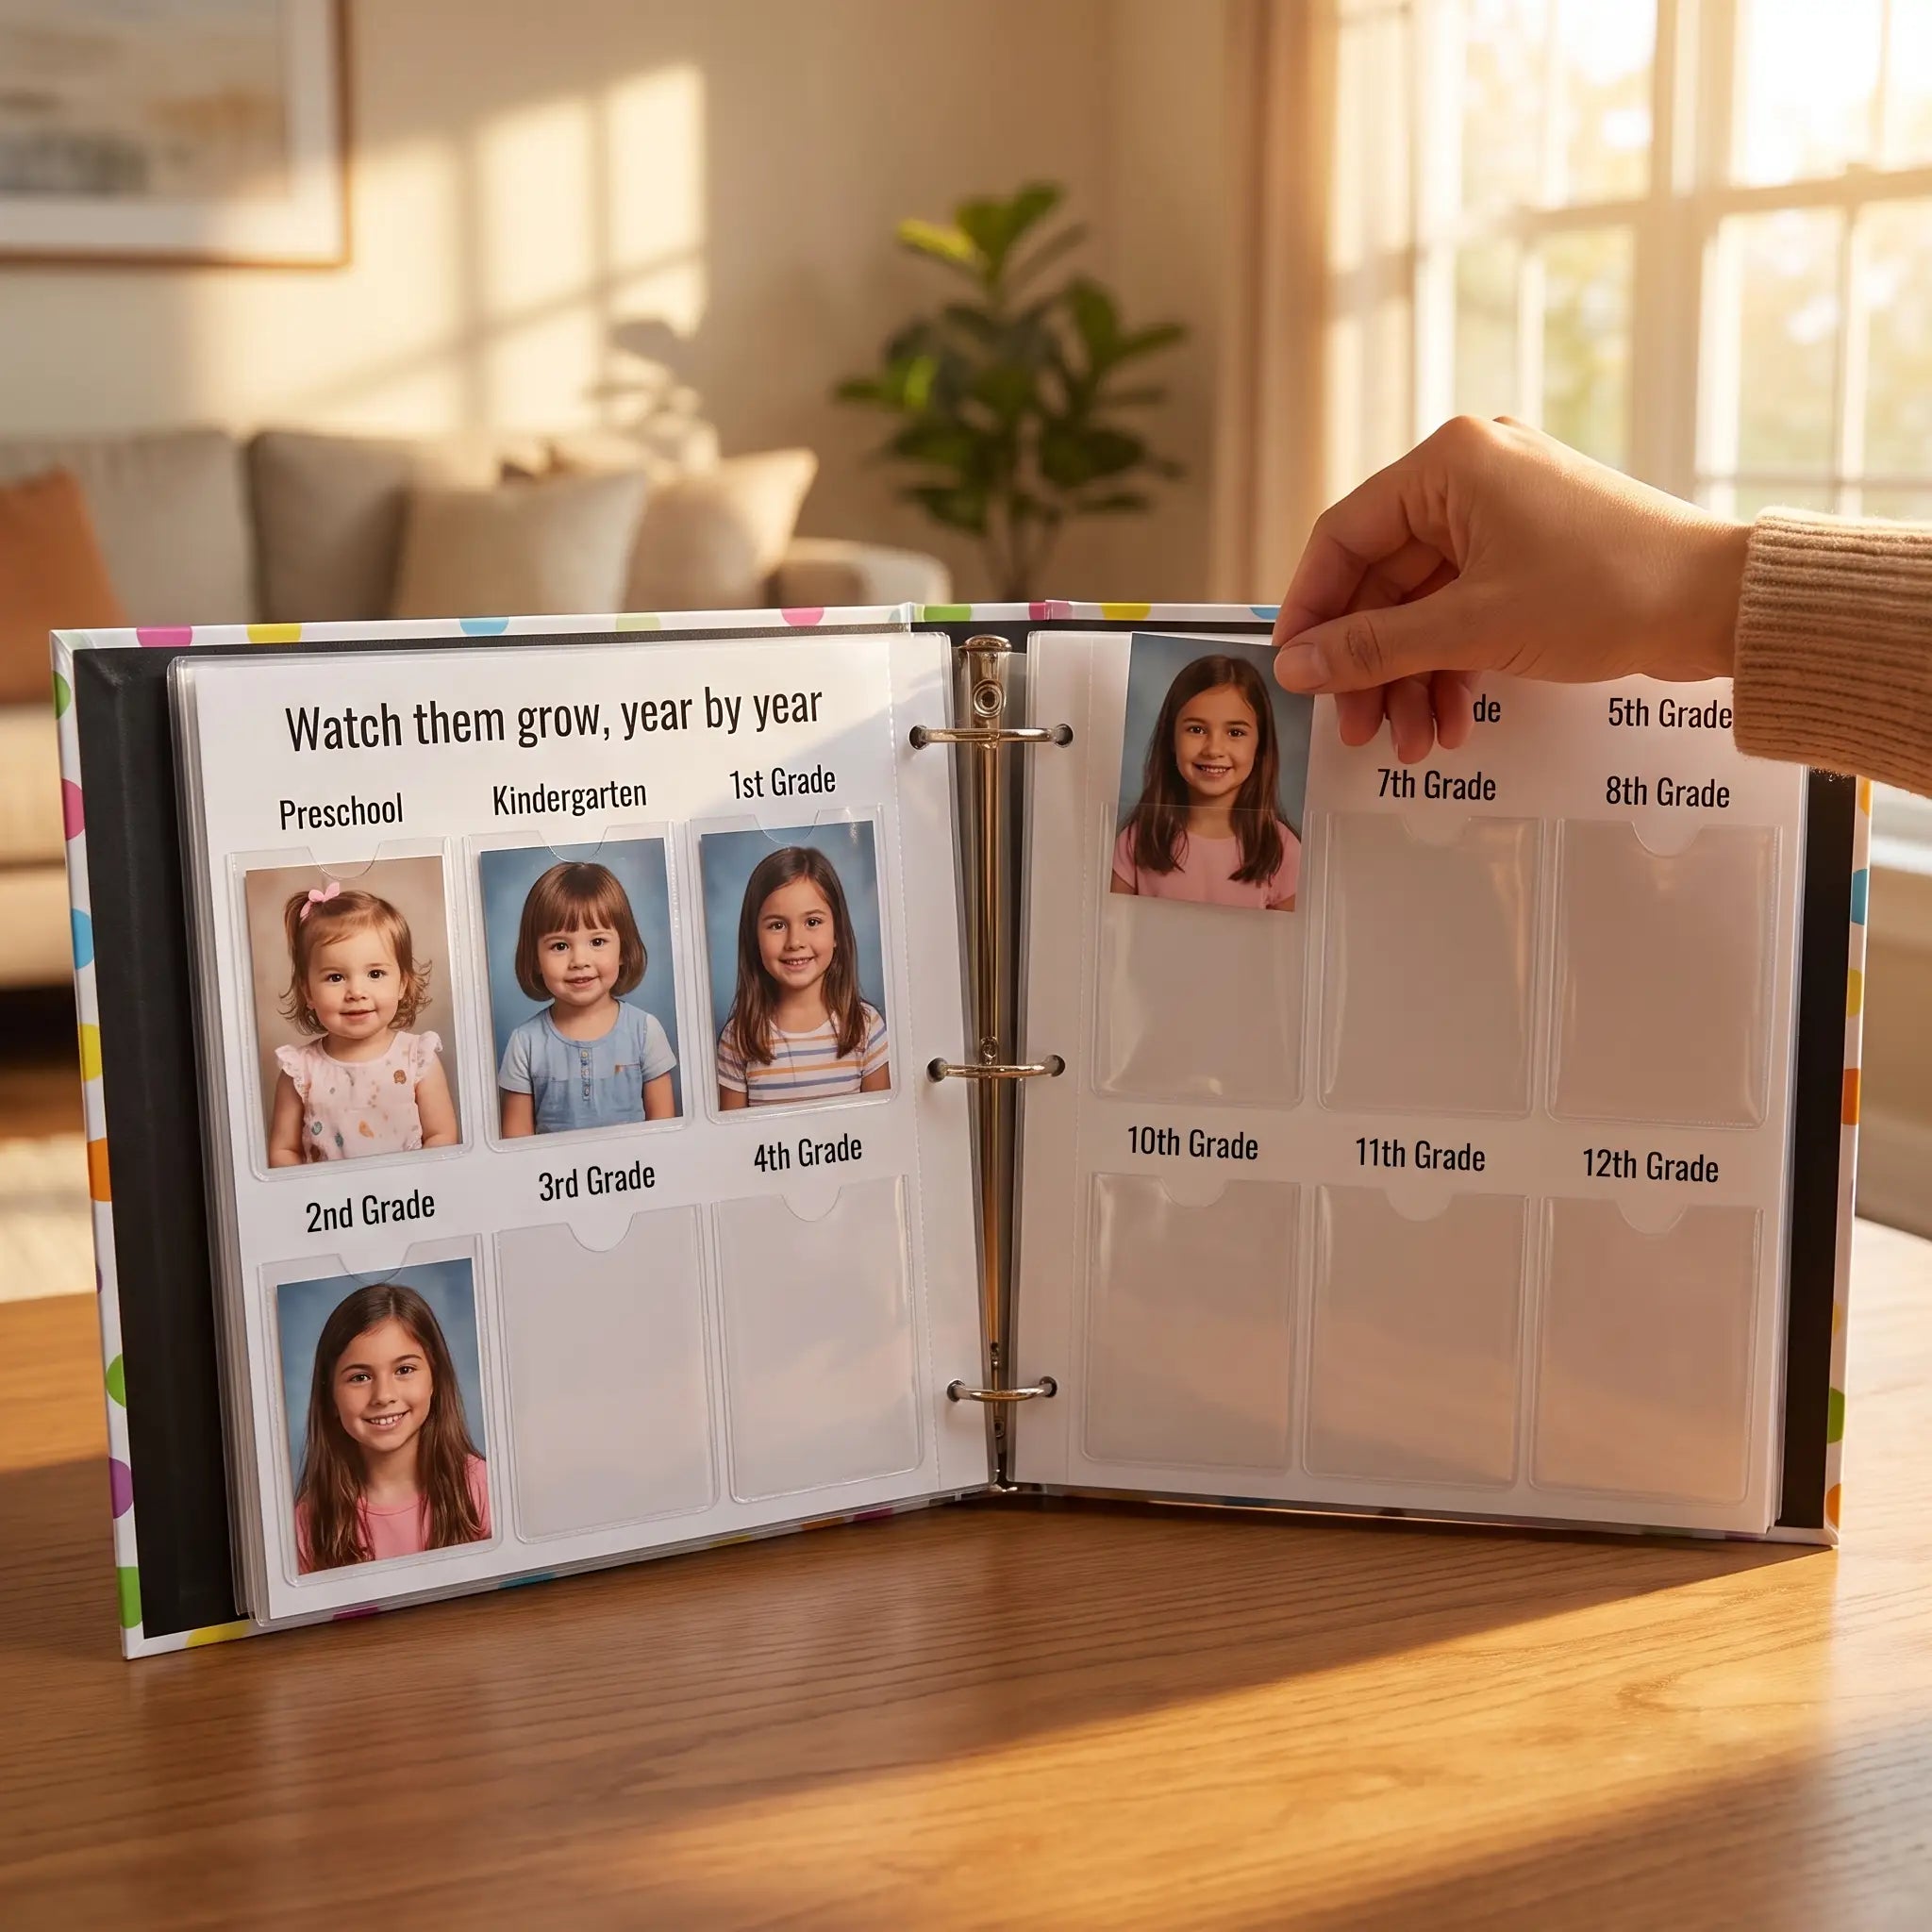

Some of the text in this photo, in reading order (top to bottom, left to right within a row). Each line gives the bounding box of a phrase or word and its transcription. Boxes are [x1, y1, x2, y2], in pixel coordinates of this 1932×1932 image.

[284, 686, 823, 752] Watch them grow, year by year
[1607, 697, 1733, 729] 5th Grade
[492, 780, 647, 817] Kindergarten
[729, 763, 836, 800] 1st Grade
[1377, 768, 1496, 802] 7th Grade
[1606, 774, 1730, 808] 8th Grade
[279, 791, 404, 831] Preschool
[754, 1132, 862, 1173] 4th Grade
[1127, 1125, 1258, 1160] 10th Grade
[1356, 1137, 1486, 1173] 11th Grade
[538, 1159, 656, 1202] 3rd Grade
[1583, 1148, 1719, 1184] 12th Grade
[306, 1189, 436, 1234] 2nd Grade
